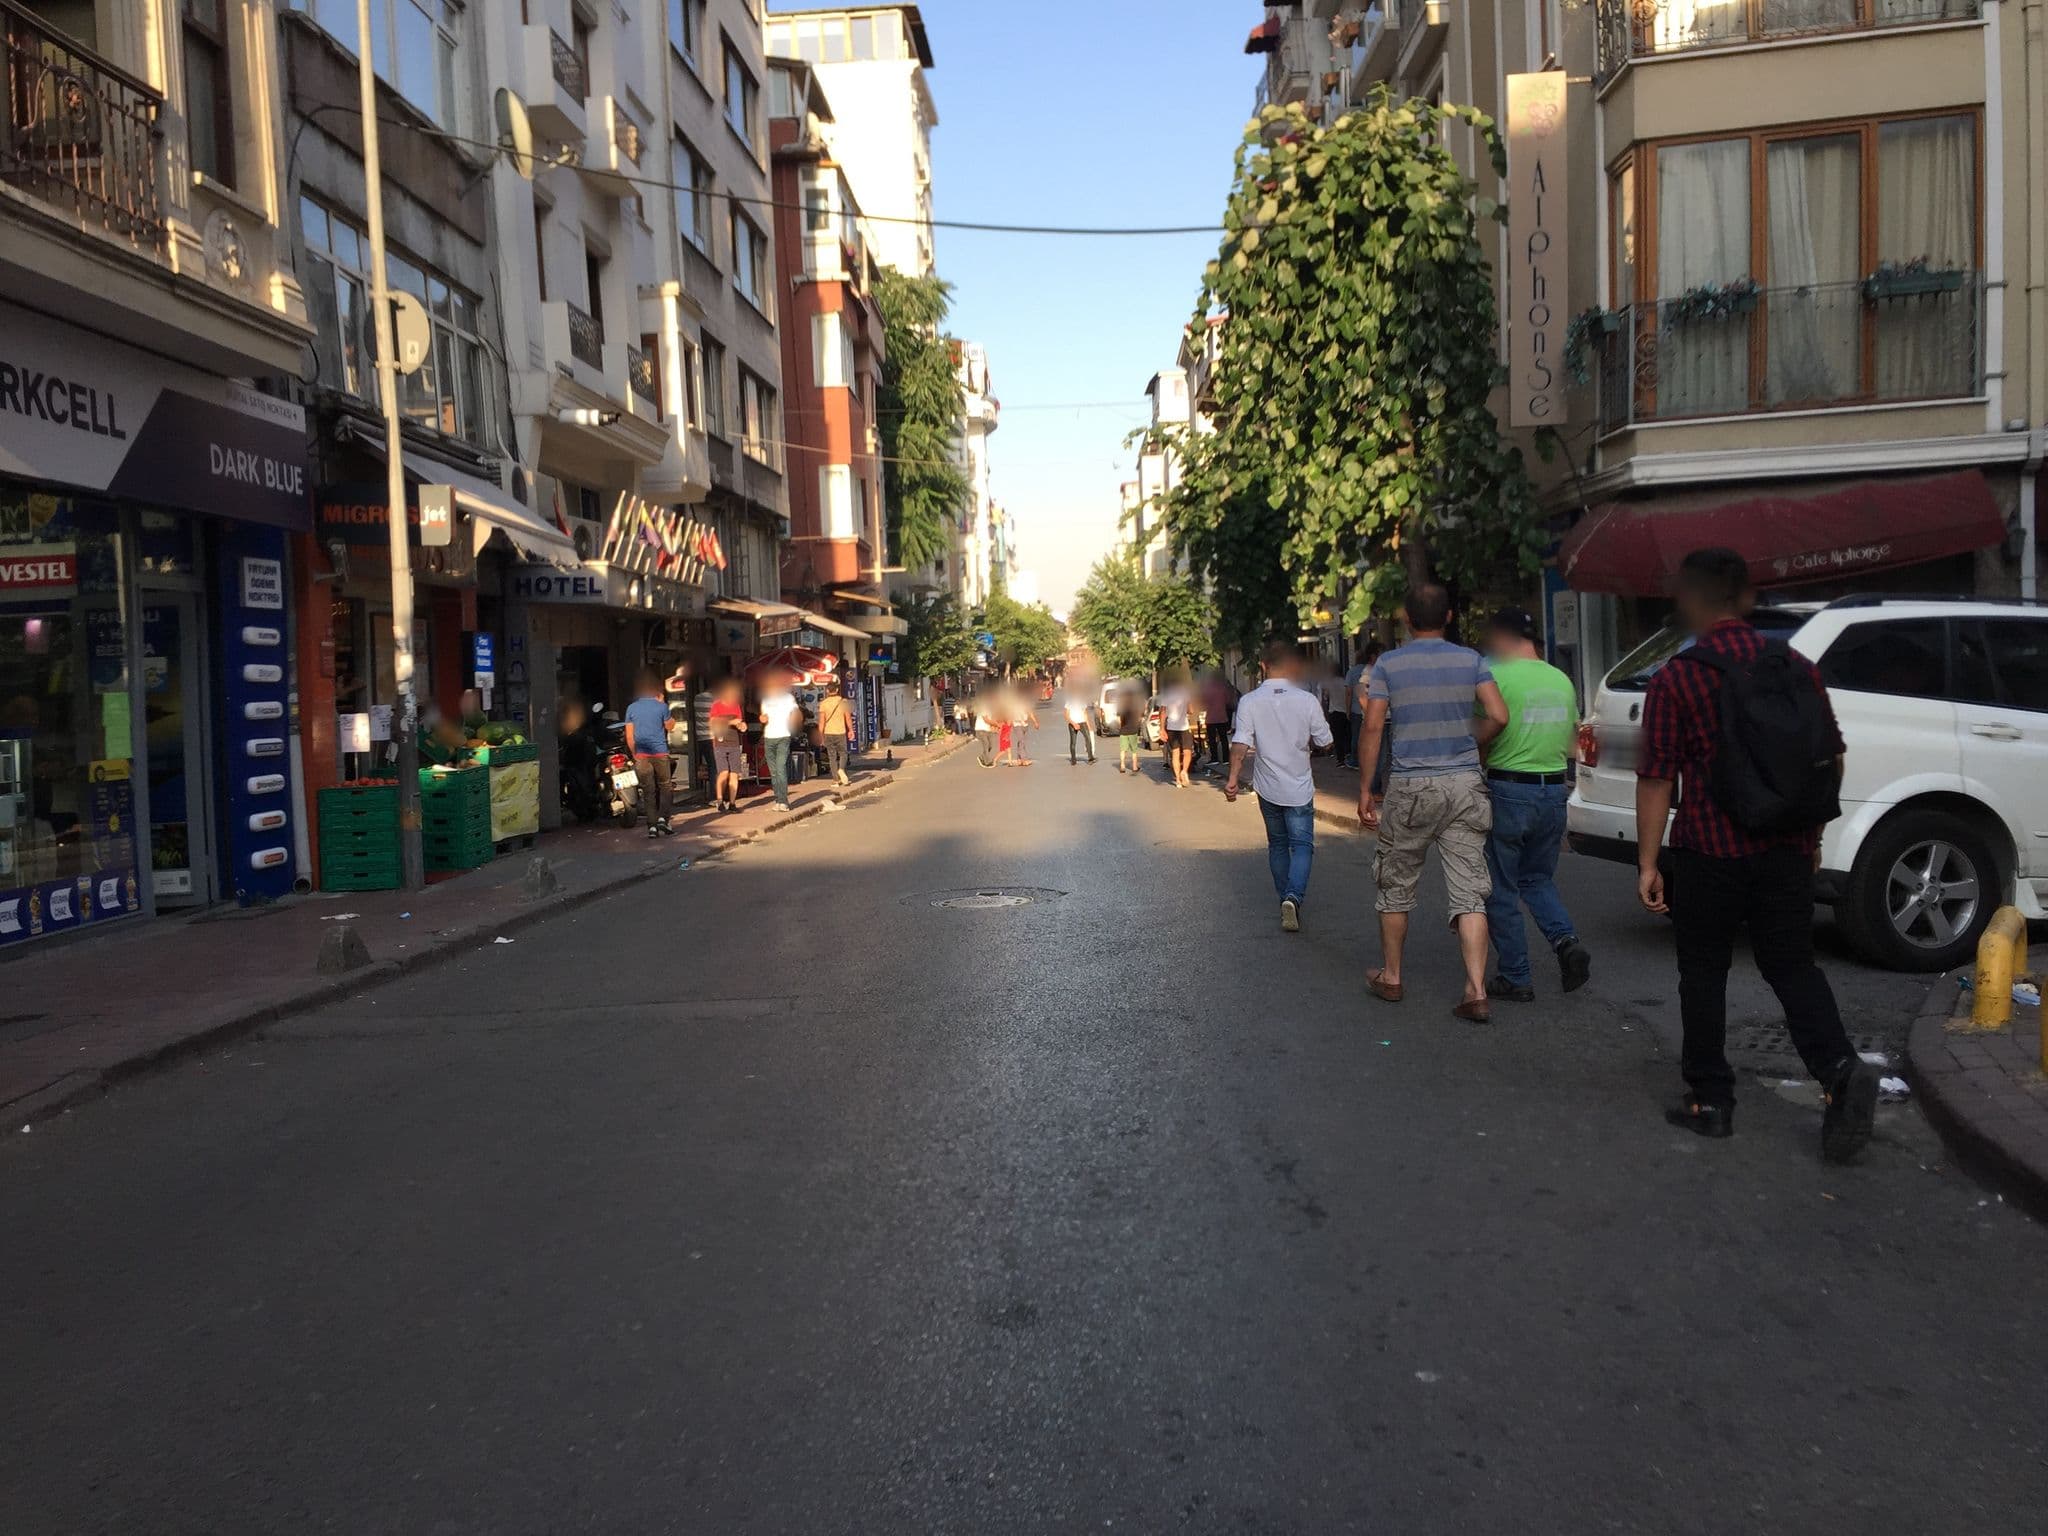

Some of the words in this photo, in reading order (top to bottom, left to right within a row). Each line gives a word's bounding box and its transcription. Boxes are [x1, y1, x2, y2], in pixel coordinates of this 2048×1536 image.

[1527, 158, 1552, 417] Alphonse
[210, 443, 259, 486] DARK
[265, 461, 304, 496] BLUE
[420, 505, 448, 526] jet
[1793, 553, 1828, 569] Cafe
[1831, 543, 1890, 566] Alphonse
[0, 562, 72, 583] VESTEL
[515, 576, 602, 597] HOTEL
